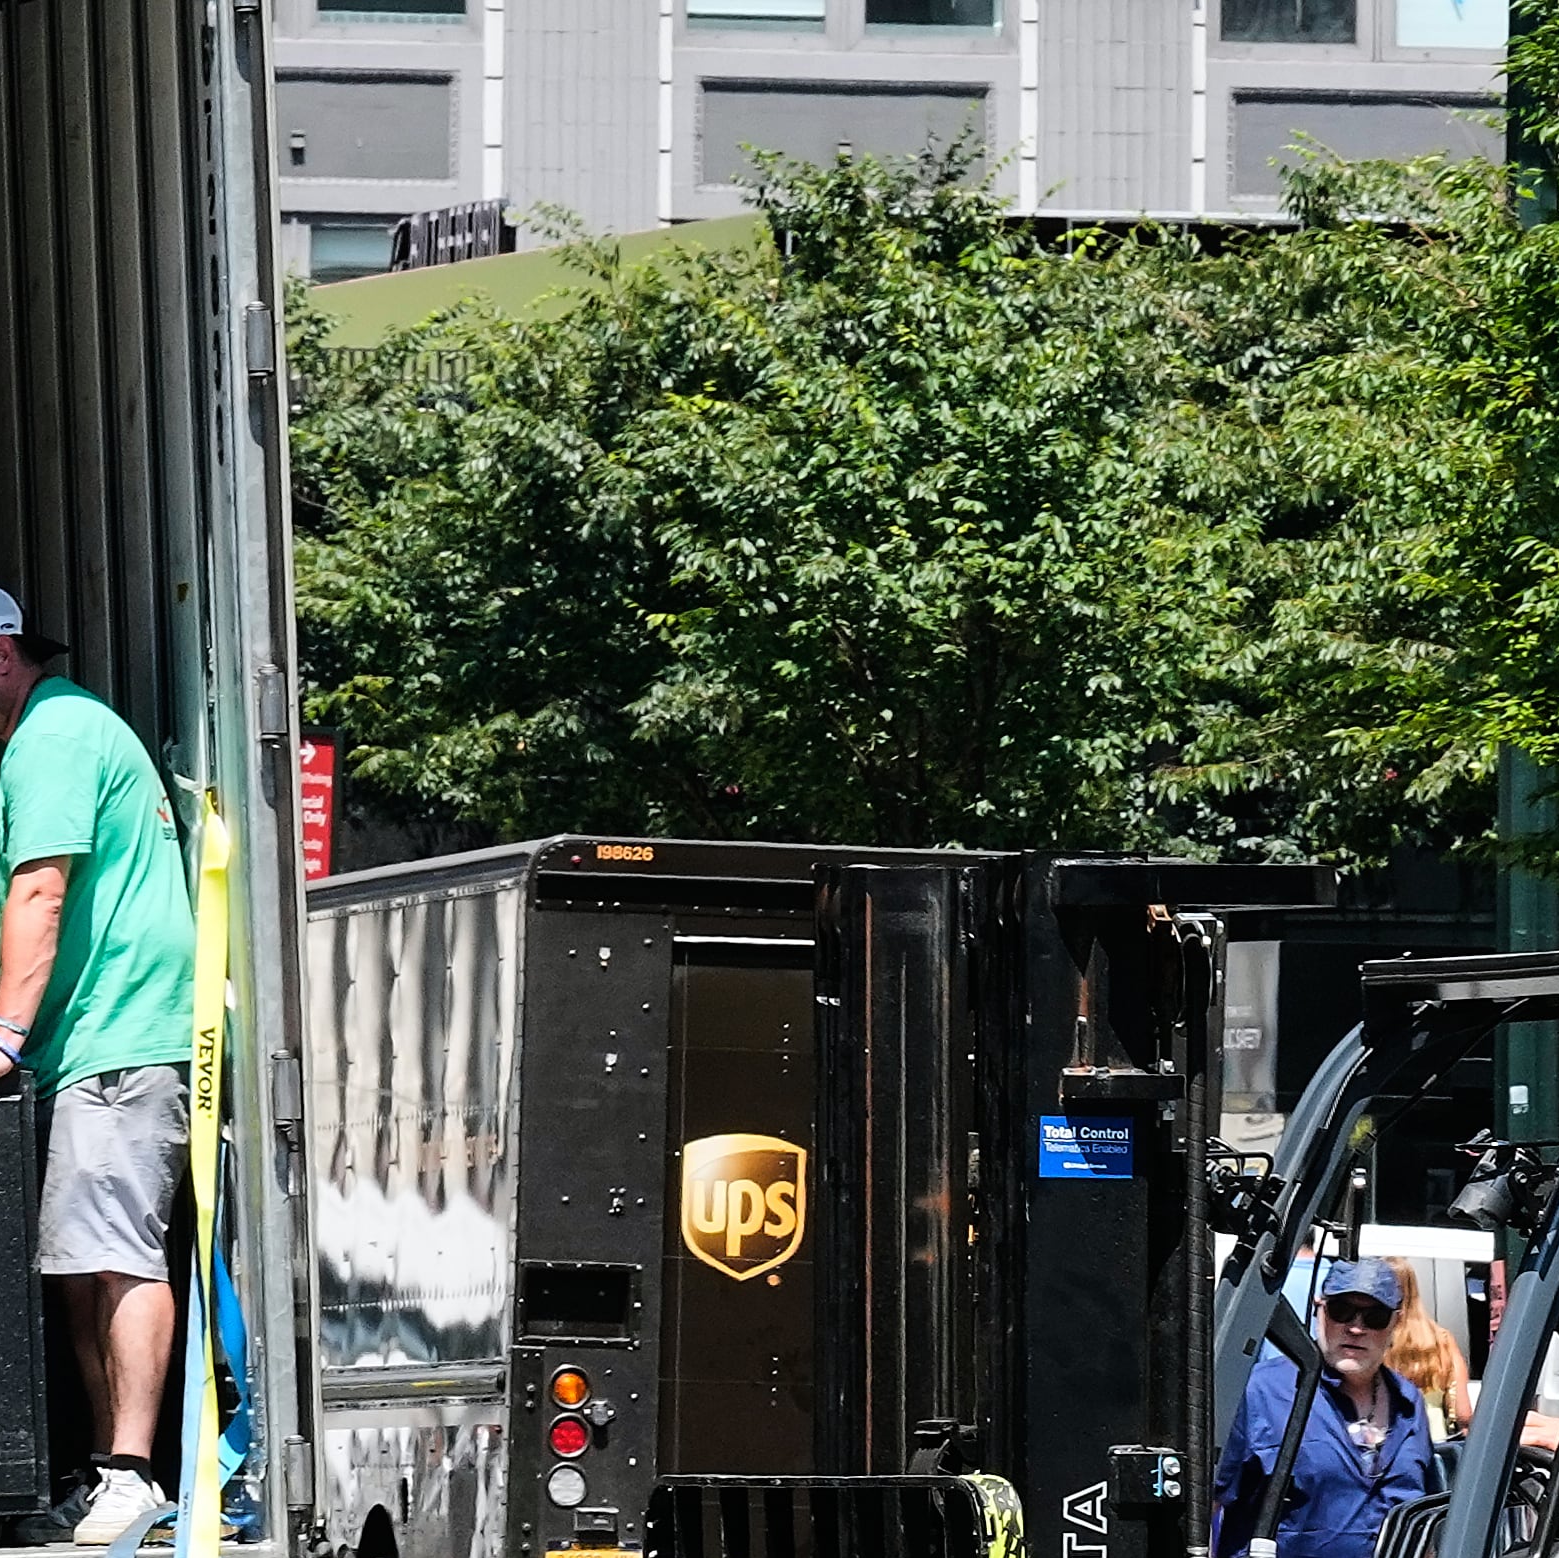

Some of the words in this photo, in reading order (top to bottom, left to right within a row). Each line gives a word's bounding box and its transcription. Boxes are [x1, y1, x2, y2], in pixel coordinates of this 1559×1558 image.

[596, 845, 654, 861] 198626
[197, 1027, 216, 1111] VEVOR
[1043, 1125, 1077, 1139] Total
[1080, 1126, 1129, 1140] Control
[1092, 1143, 1128, 1154] Enabled
[692, 1179, 797, 1257] ups
